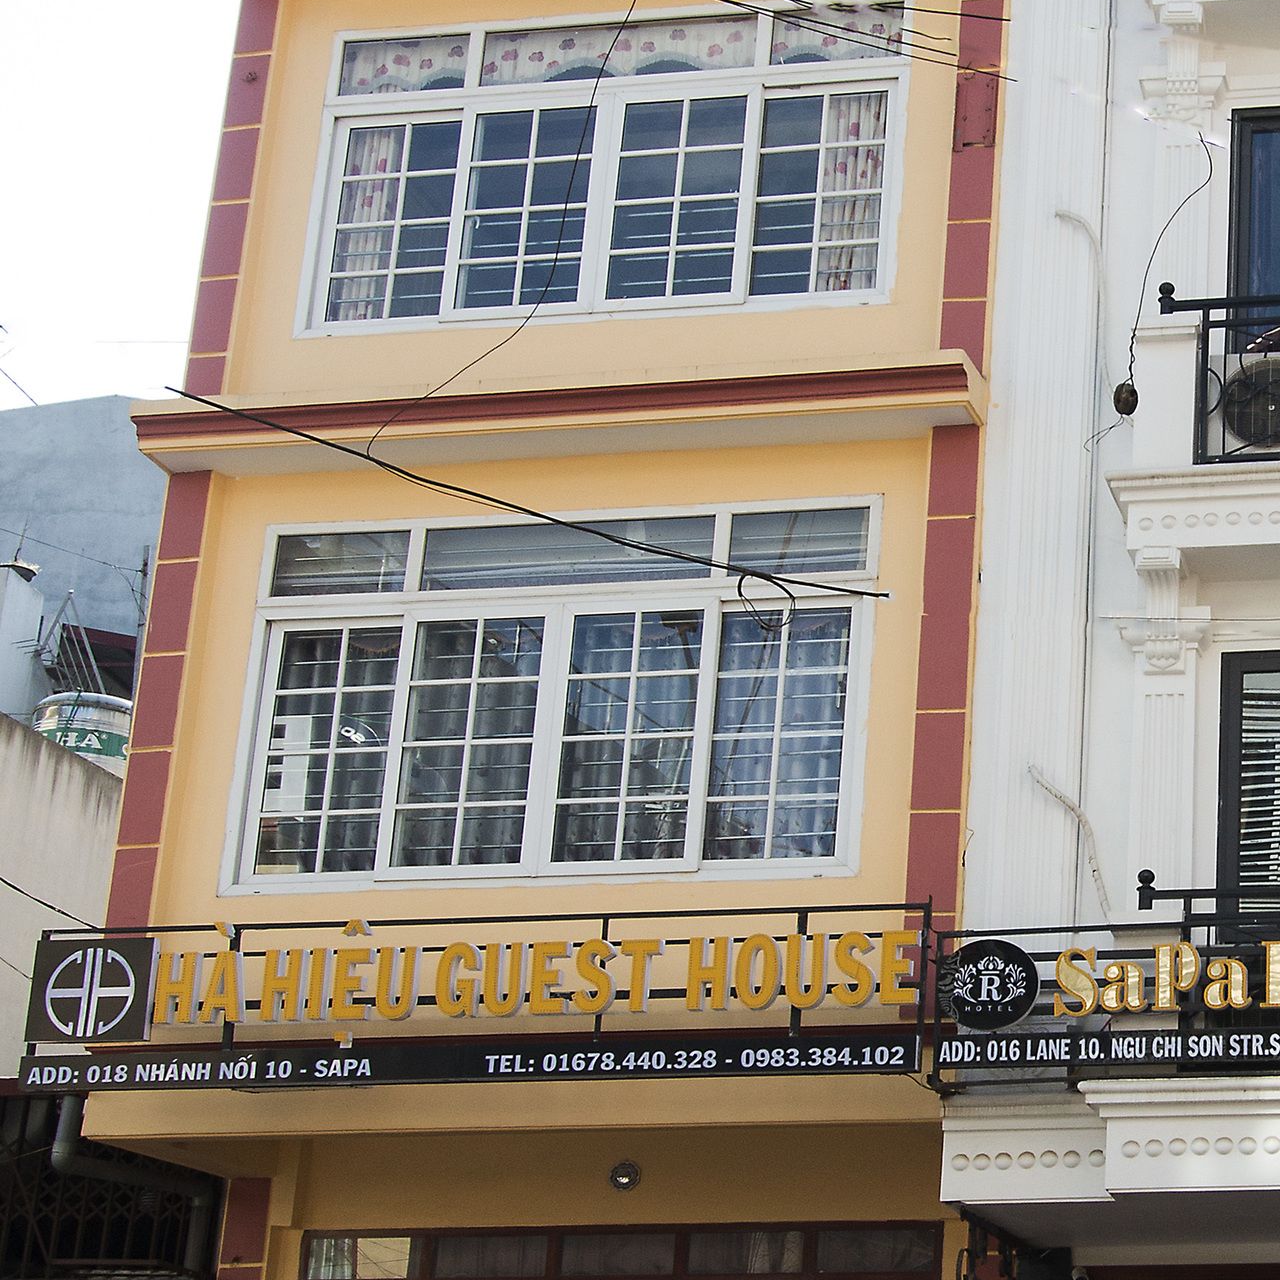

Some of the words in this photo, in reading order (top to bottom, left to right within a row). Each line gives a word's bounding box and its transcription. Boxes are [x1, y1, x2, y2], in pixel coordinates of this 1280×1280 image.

[152, 921, 244, 1024] HÀ
[435, 938, 666, 1018] GUEST
[685, 929, 923, 1012] HOUSE
[1053, 941, 1252, 1018] SaPa
[978, 975, 1002, 1001] R
[485, 1054, 535, 1073] TEL:
[542, 1050, 717, 1072] 01678.440.328
[740, 1046, 905, 1069] 0983.384.102
[939, 1041, 981, 1063] ADD:
[986, 1039, 1020, 1062] 016
[1025, 1037, 1071, 1061] LANE
[1078, 1038, 1105, 1060] 10.
[1111, 1036, 1147, 1059] NGU
[1152, 1036, 1182, 1058] CHI
[1187, 1034, 1224, 1057] SON
[27, 1066, 79, 1085] ADD:
[87, 1064, 128, 1084] 018
[135, 1057, 212, 1082] NHÁNH
[219, 1054, 257, 1080] NỐI
[265, 1060, 293, 1079] 10
[313, 1058, 372, 1078] SAPA
